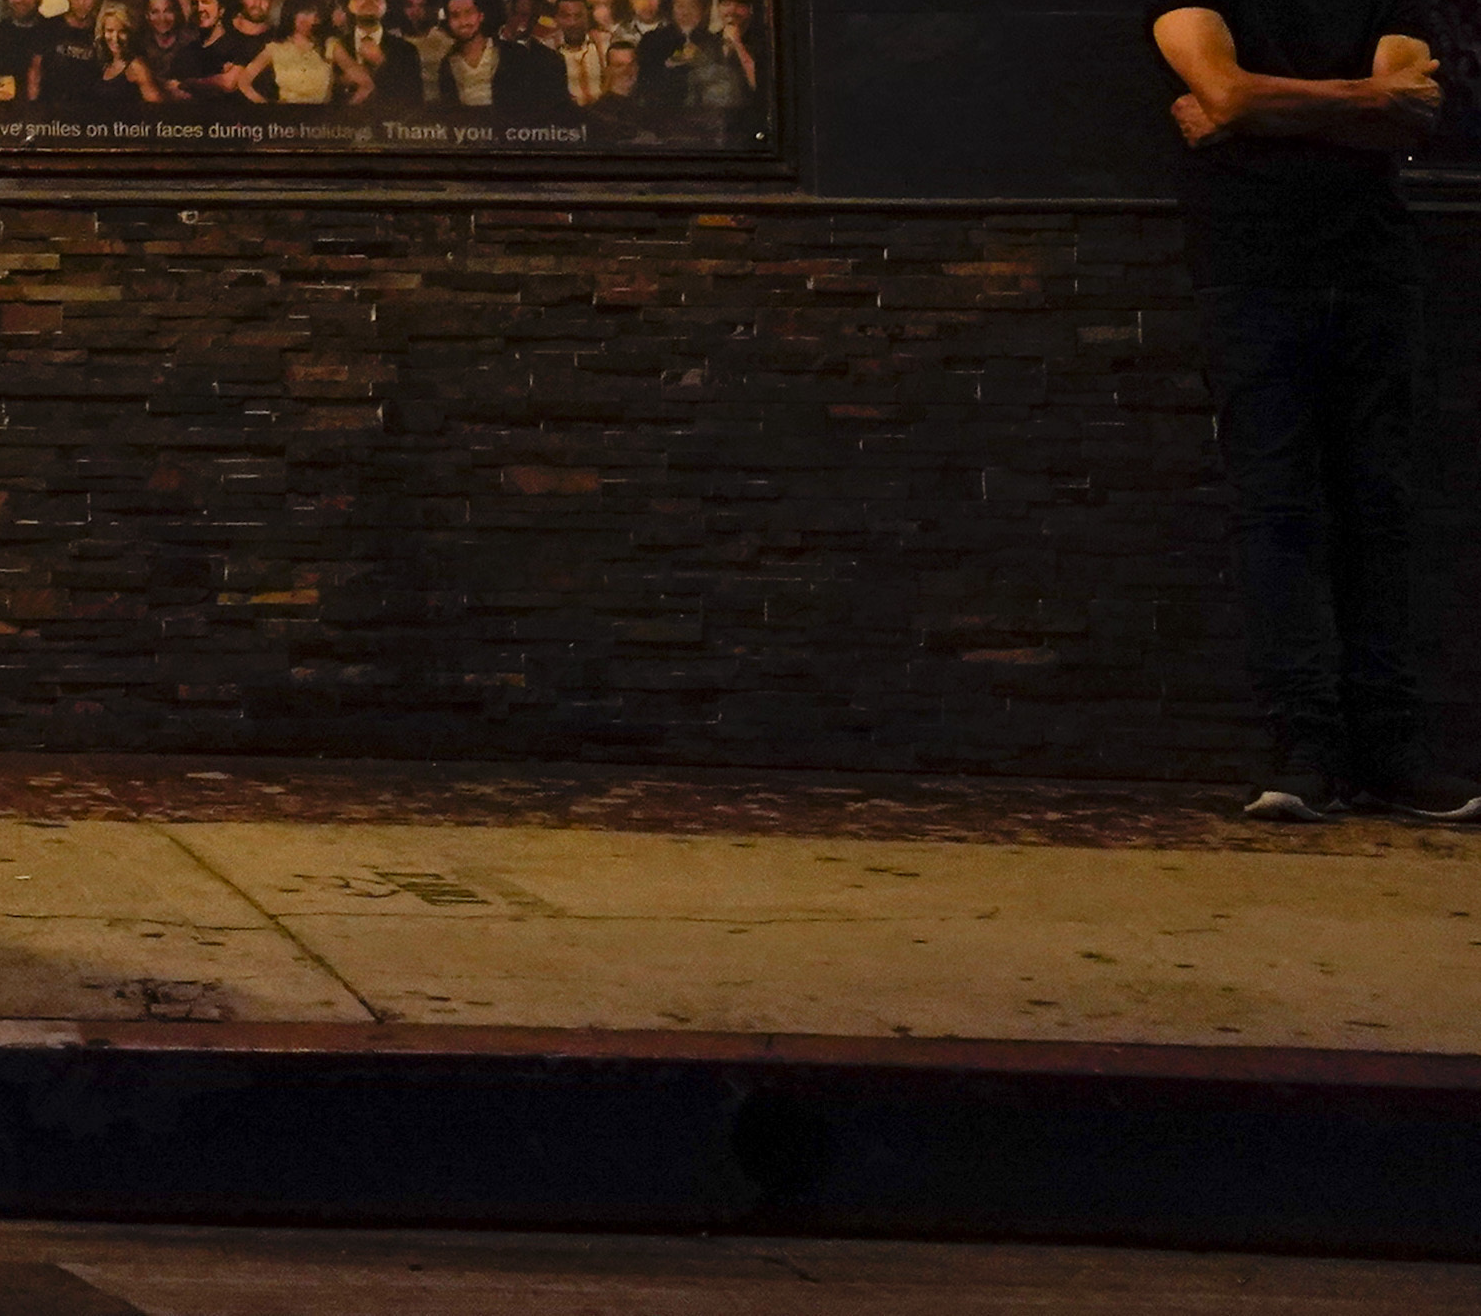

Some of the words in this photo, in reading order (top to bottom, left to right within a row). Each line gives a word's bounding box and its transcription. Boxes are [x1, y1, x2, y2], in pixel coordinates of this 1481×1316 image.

[25, 120, 82, 138] smiles
[86, 124, 108, 138] on
[113, 120, 151, 138] their
[156, 120, 204, 139] faces
[209, 121, 264, 142] during
[268, 122, 296, 139] the
[382, 121, 448, 141] Thank
[505, 122, 588, 143] comics!
